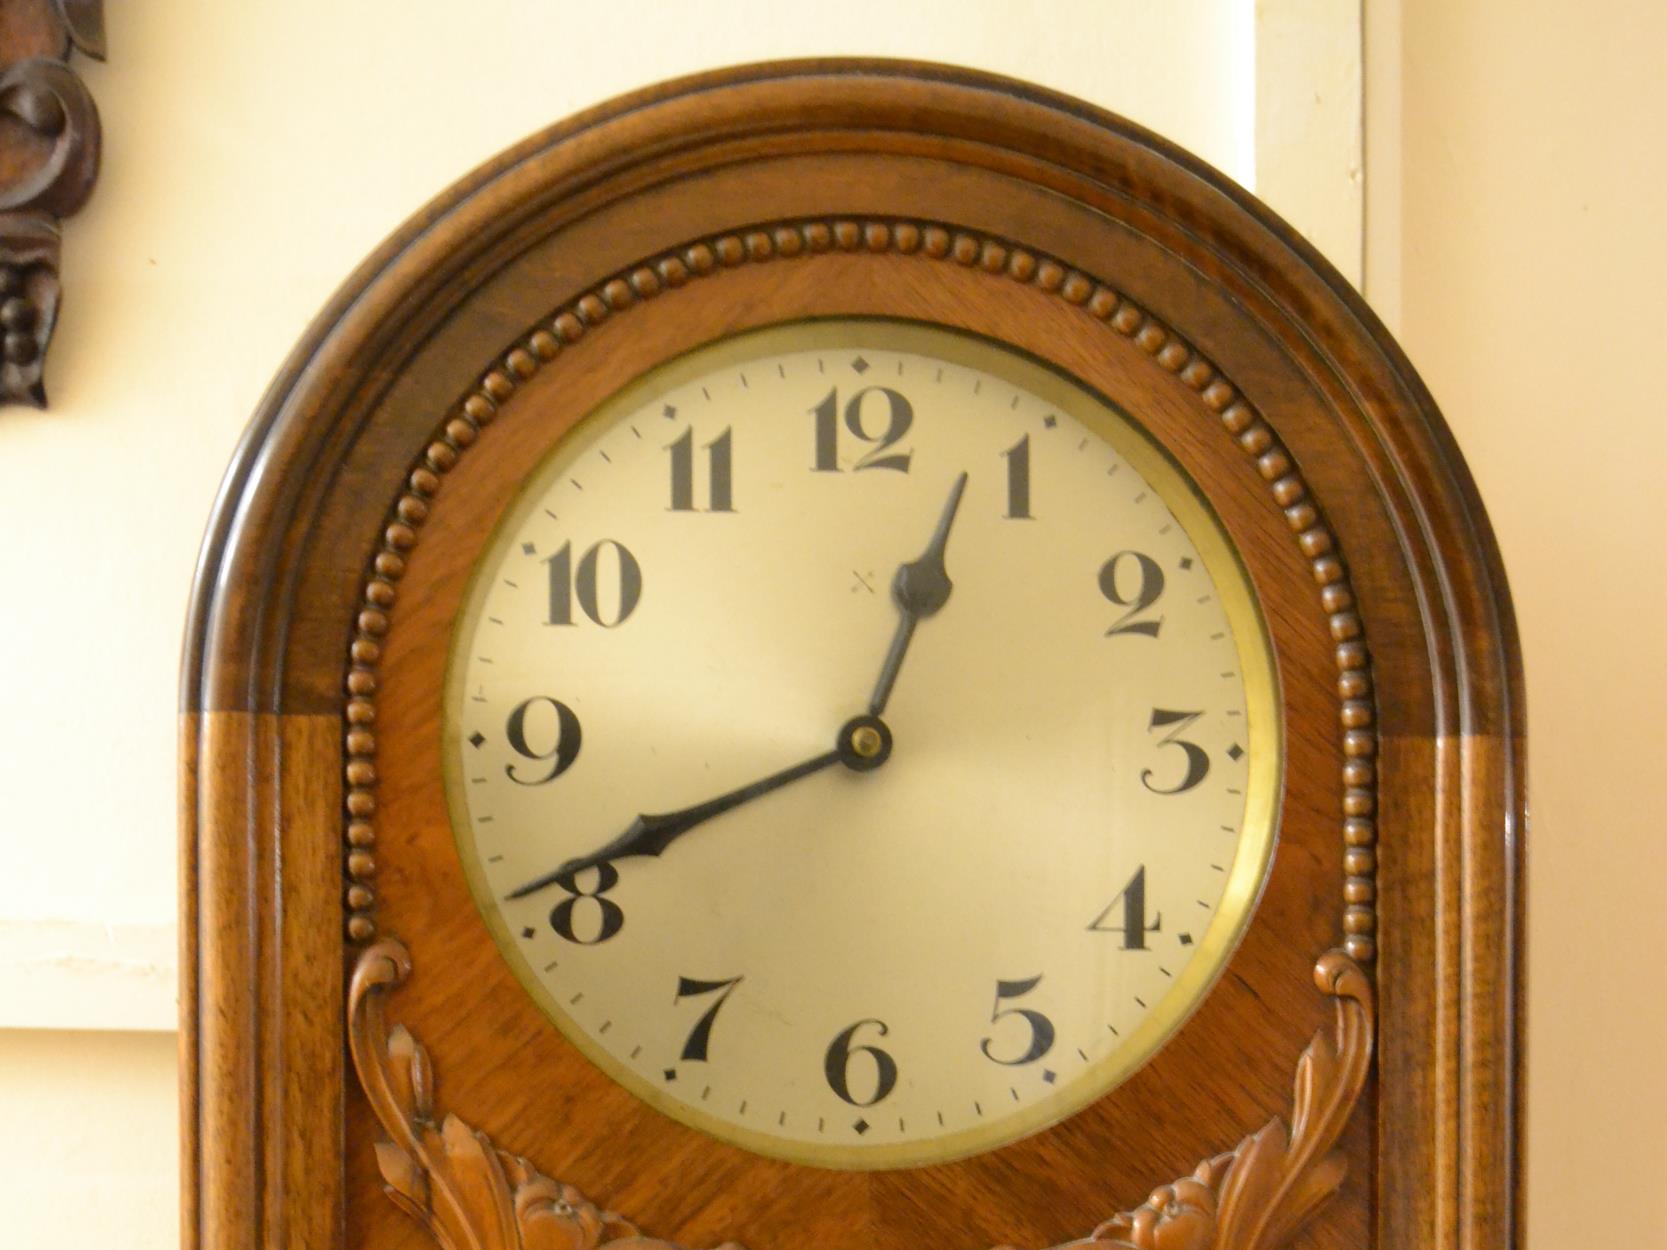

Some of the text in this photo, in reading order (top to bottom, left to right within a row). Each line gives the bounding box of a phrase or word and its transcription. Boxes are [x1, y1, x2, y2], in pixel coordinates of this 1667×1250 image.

[664, 425, 738, 513] 11
[807, 387, 914, 473] 12
[1001, 433, 1036, 520] 1
[540, 539, 642, 628] 10
[1098, 552, 1164, 638] 2
[505, 696, 582, 785] 9
[1141, 708, 1210, 795] 3
[549, 860, 625, 946] 8
[1088, 865, 1161, 950] 4
[673, 974, 743, 1063] 7
[981, 976, 1055, 1066] 5
[824, 1020, 898, 1106] 6
